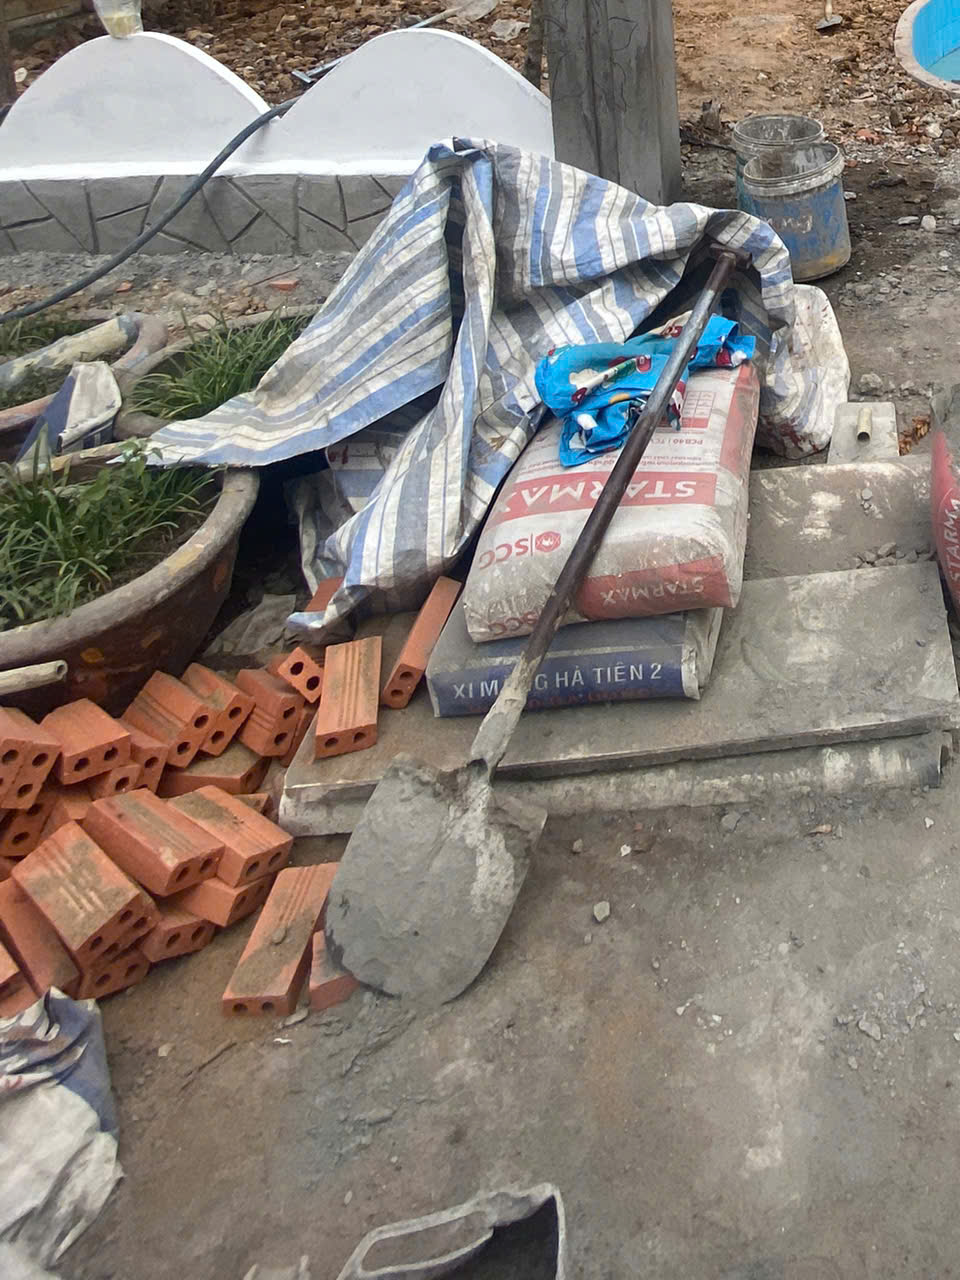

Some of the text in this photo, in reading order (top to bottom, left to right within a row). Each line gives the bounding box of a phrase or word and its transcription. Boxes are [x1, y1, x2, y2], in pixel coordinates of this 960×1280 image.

[599, 574, 706, 607] STARMAX
[453, 681, 474, 699] XI
[479, 673, 549, 698] MG
[592, 660, 644, 685] TIÊN
[650, 662, 663, 680] 2
